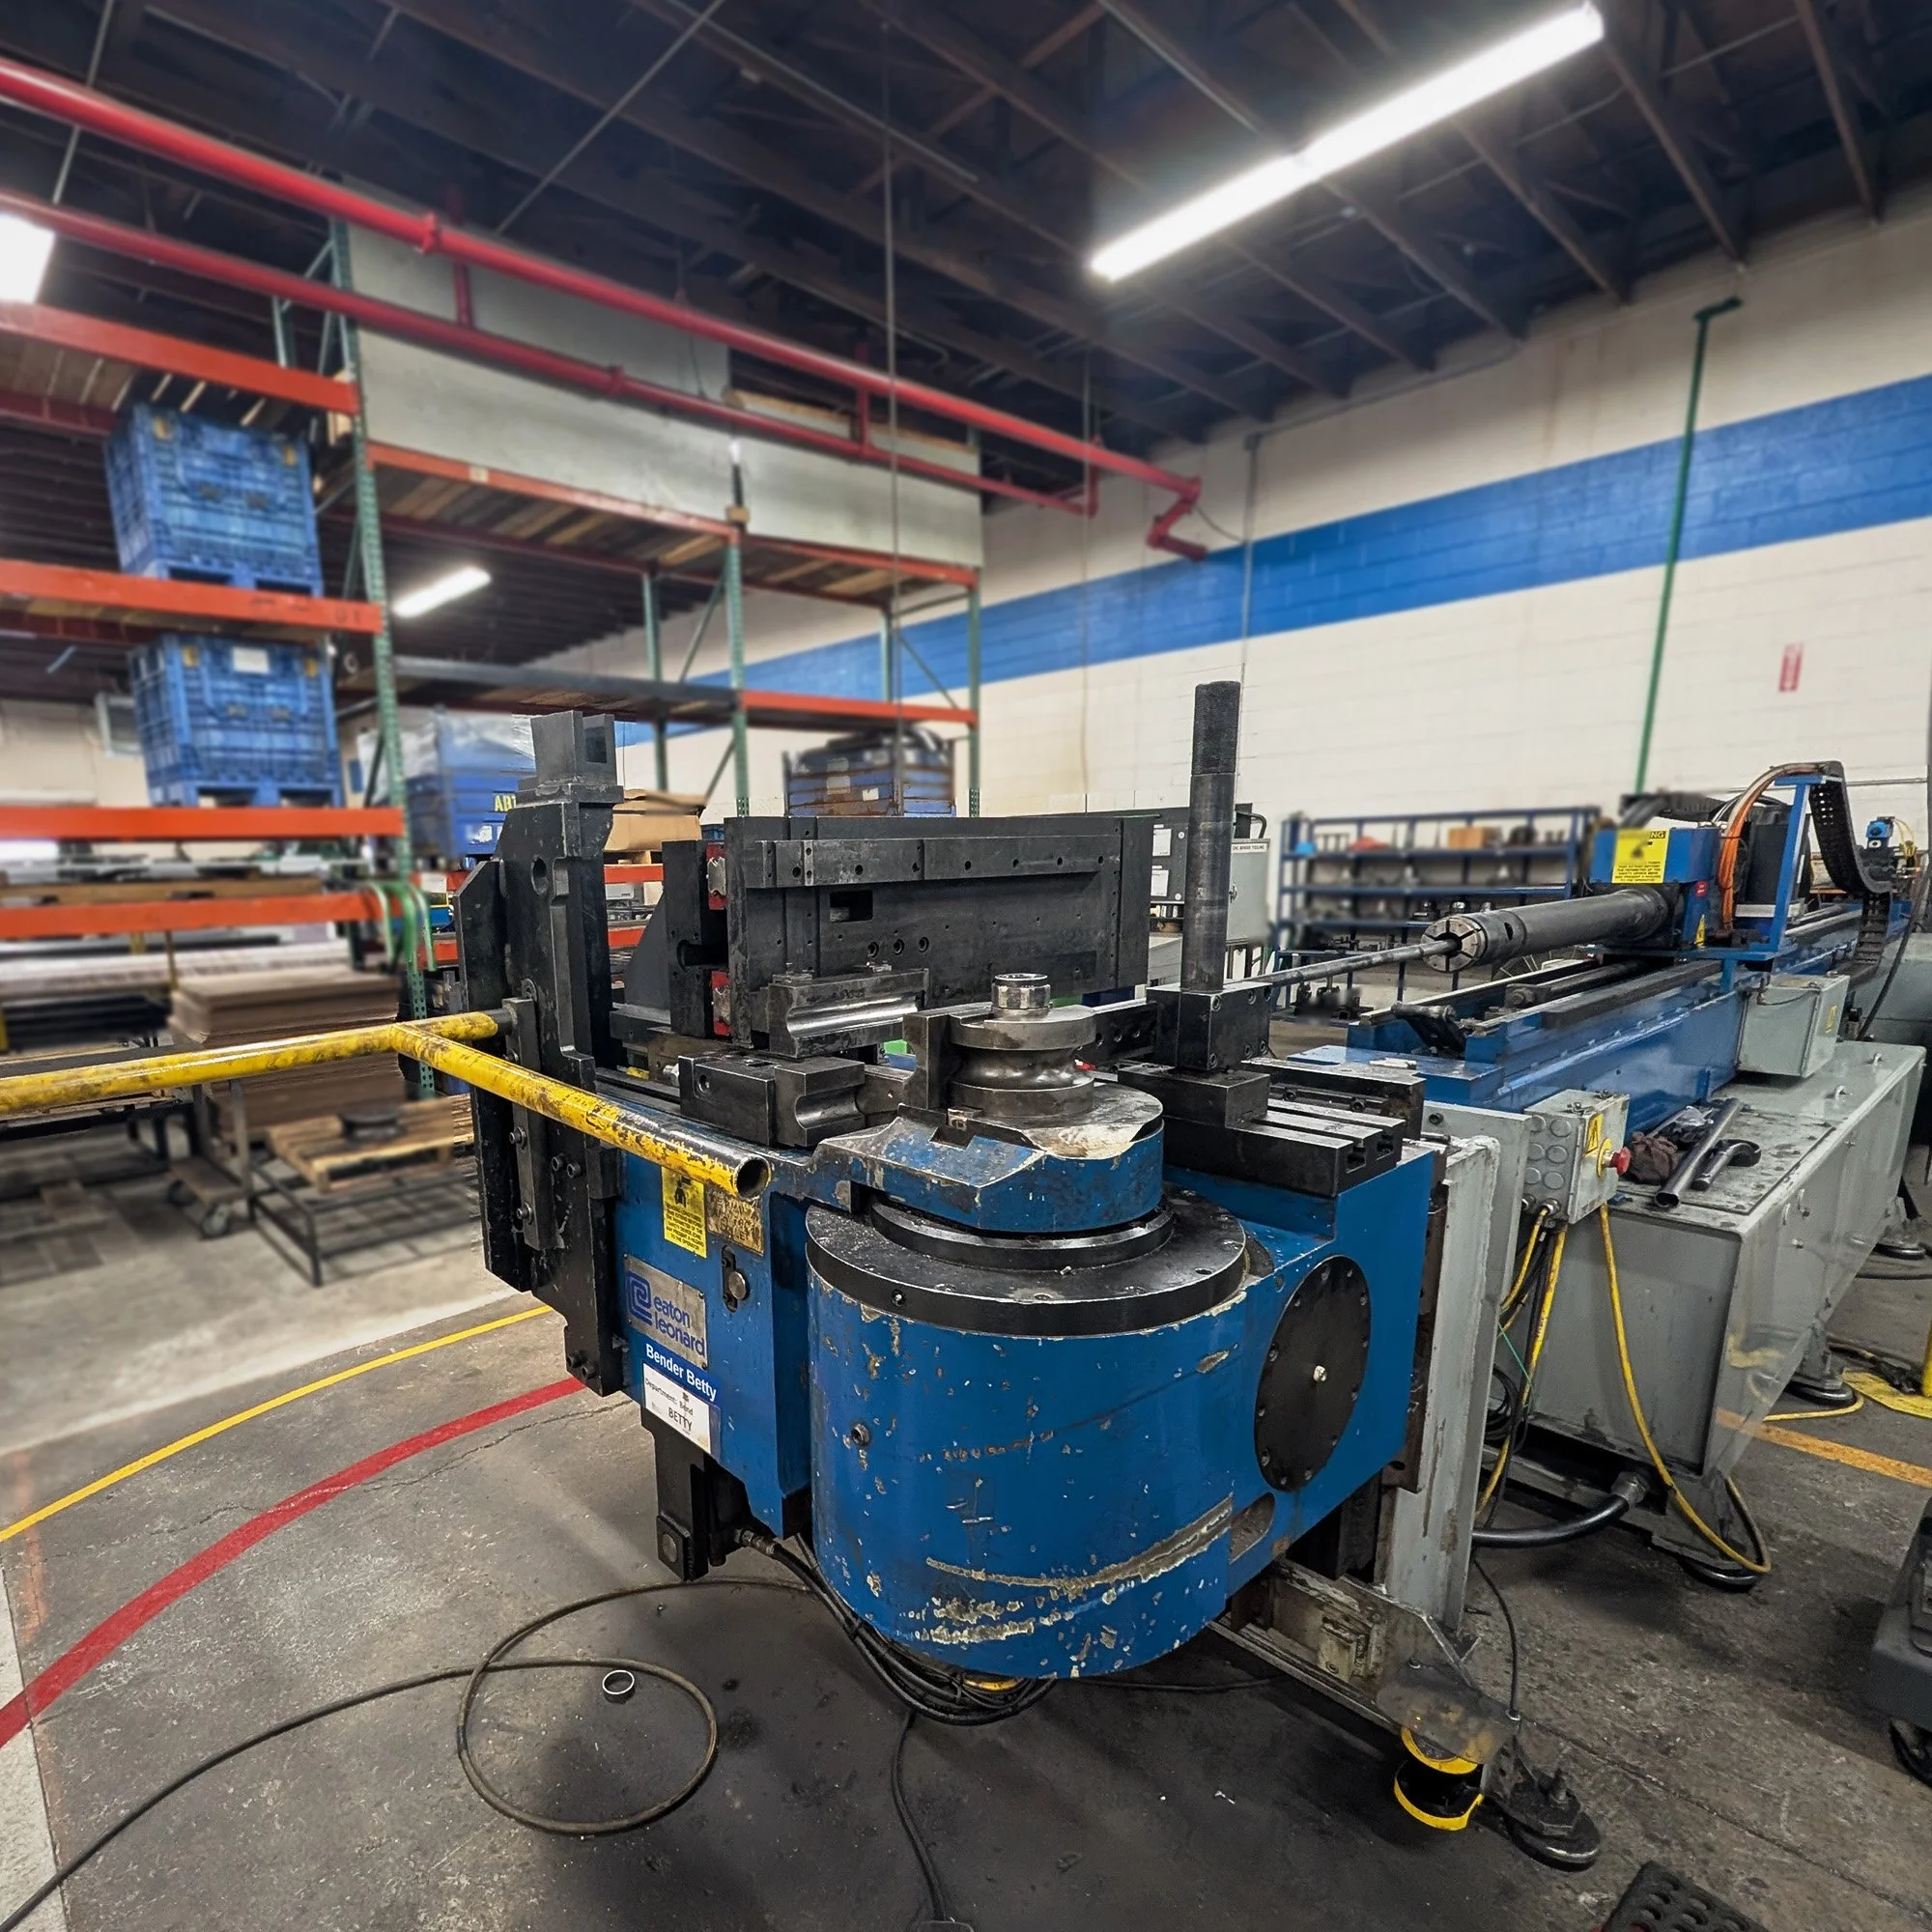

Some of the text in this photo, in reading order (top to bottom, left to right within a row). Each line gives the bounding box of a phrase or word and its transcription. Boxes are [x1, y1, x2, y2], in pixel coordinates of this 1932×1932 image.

[653, 1295, 690, 1328] eaton
[655, 1311, 705, 1358] leonard
[645, 1343, 717, 1402] Bender Betty
[668, 1406, 693, 1432] BETTY
